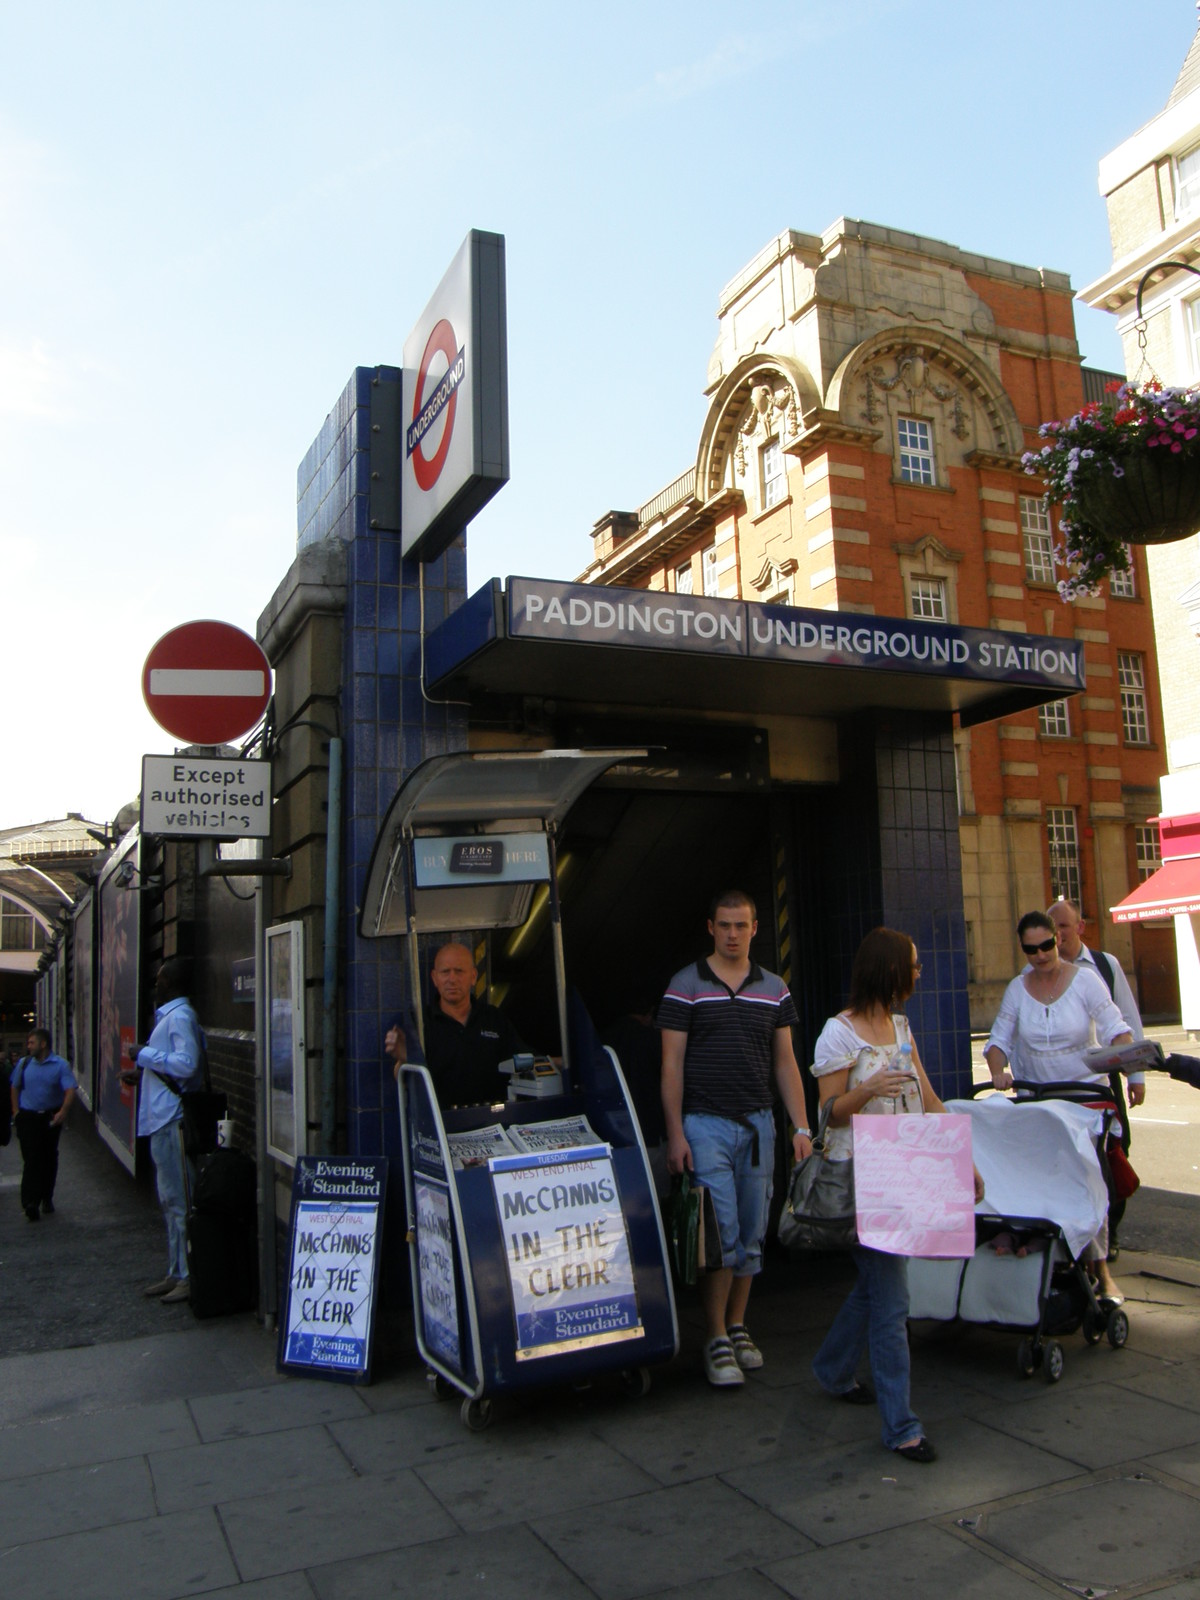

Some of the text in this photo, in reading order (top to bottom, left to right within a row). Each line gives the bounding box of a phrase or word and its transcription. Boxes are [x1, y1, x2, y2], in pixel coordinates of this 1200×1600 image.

[409, 358, 464, 448] UNDERGROUND
[525, 594, 1077, 675] PADDINGTON UNDERGROUND STATION
[173, 765, 245, 786] Except
[151, 788, 264, 807] authorised
[423, 855, 449, 868] BUY
[505, 850, 542, 864] HERE
[461, 846, 493, 855] EROS
[537, 1153, 569, 1164] TUESDAY
[316, 1161, 376, 1180] Evening
[510, 1161, 597, 1180] WEST END FINAL
[312, 1178, 380, 1196] Standard
[309, 1214, 328, 1223] WEST
[346, 1215, 364, 1224] FINAL
[298, 1231, 372, 1255] McCANNS
[511, 1218, 609, 1262] IN THE
[296, 1266, 360, 1293] IN THE
[529, 1258, 610, 1297] CLEAR
[302, 1298, 354, 1325] CLEAR
[555, 1302, 620, 1324] Evening
[555, 1312, 630, 1338] Standard
[312, 1335, 356, 1354] Evening
[310, 1348, 360, 1365] Standard
